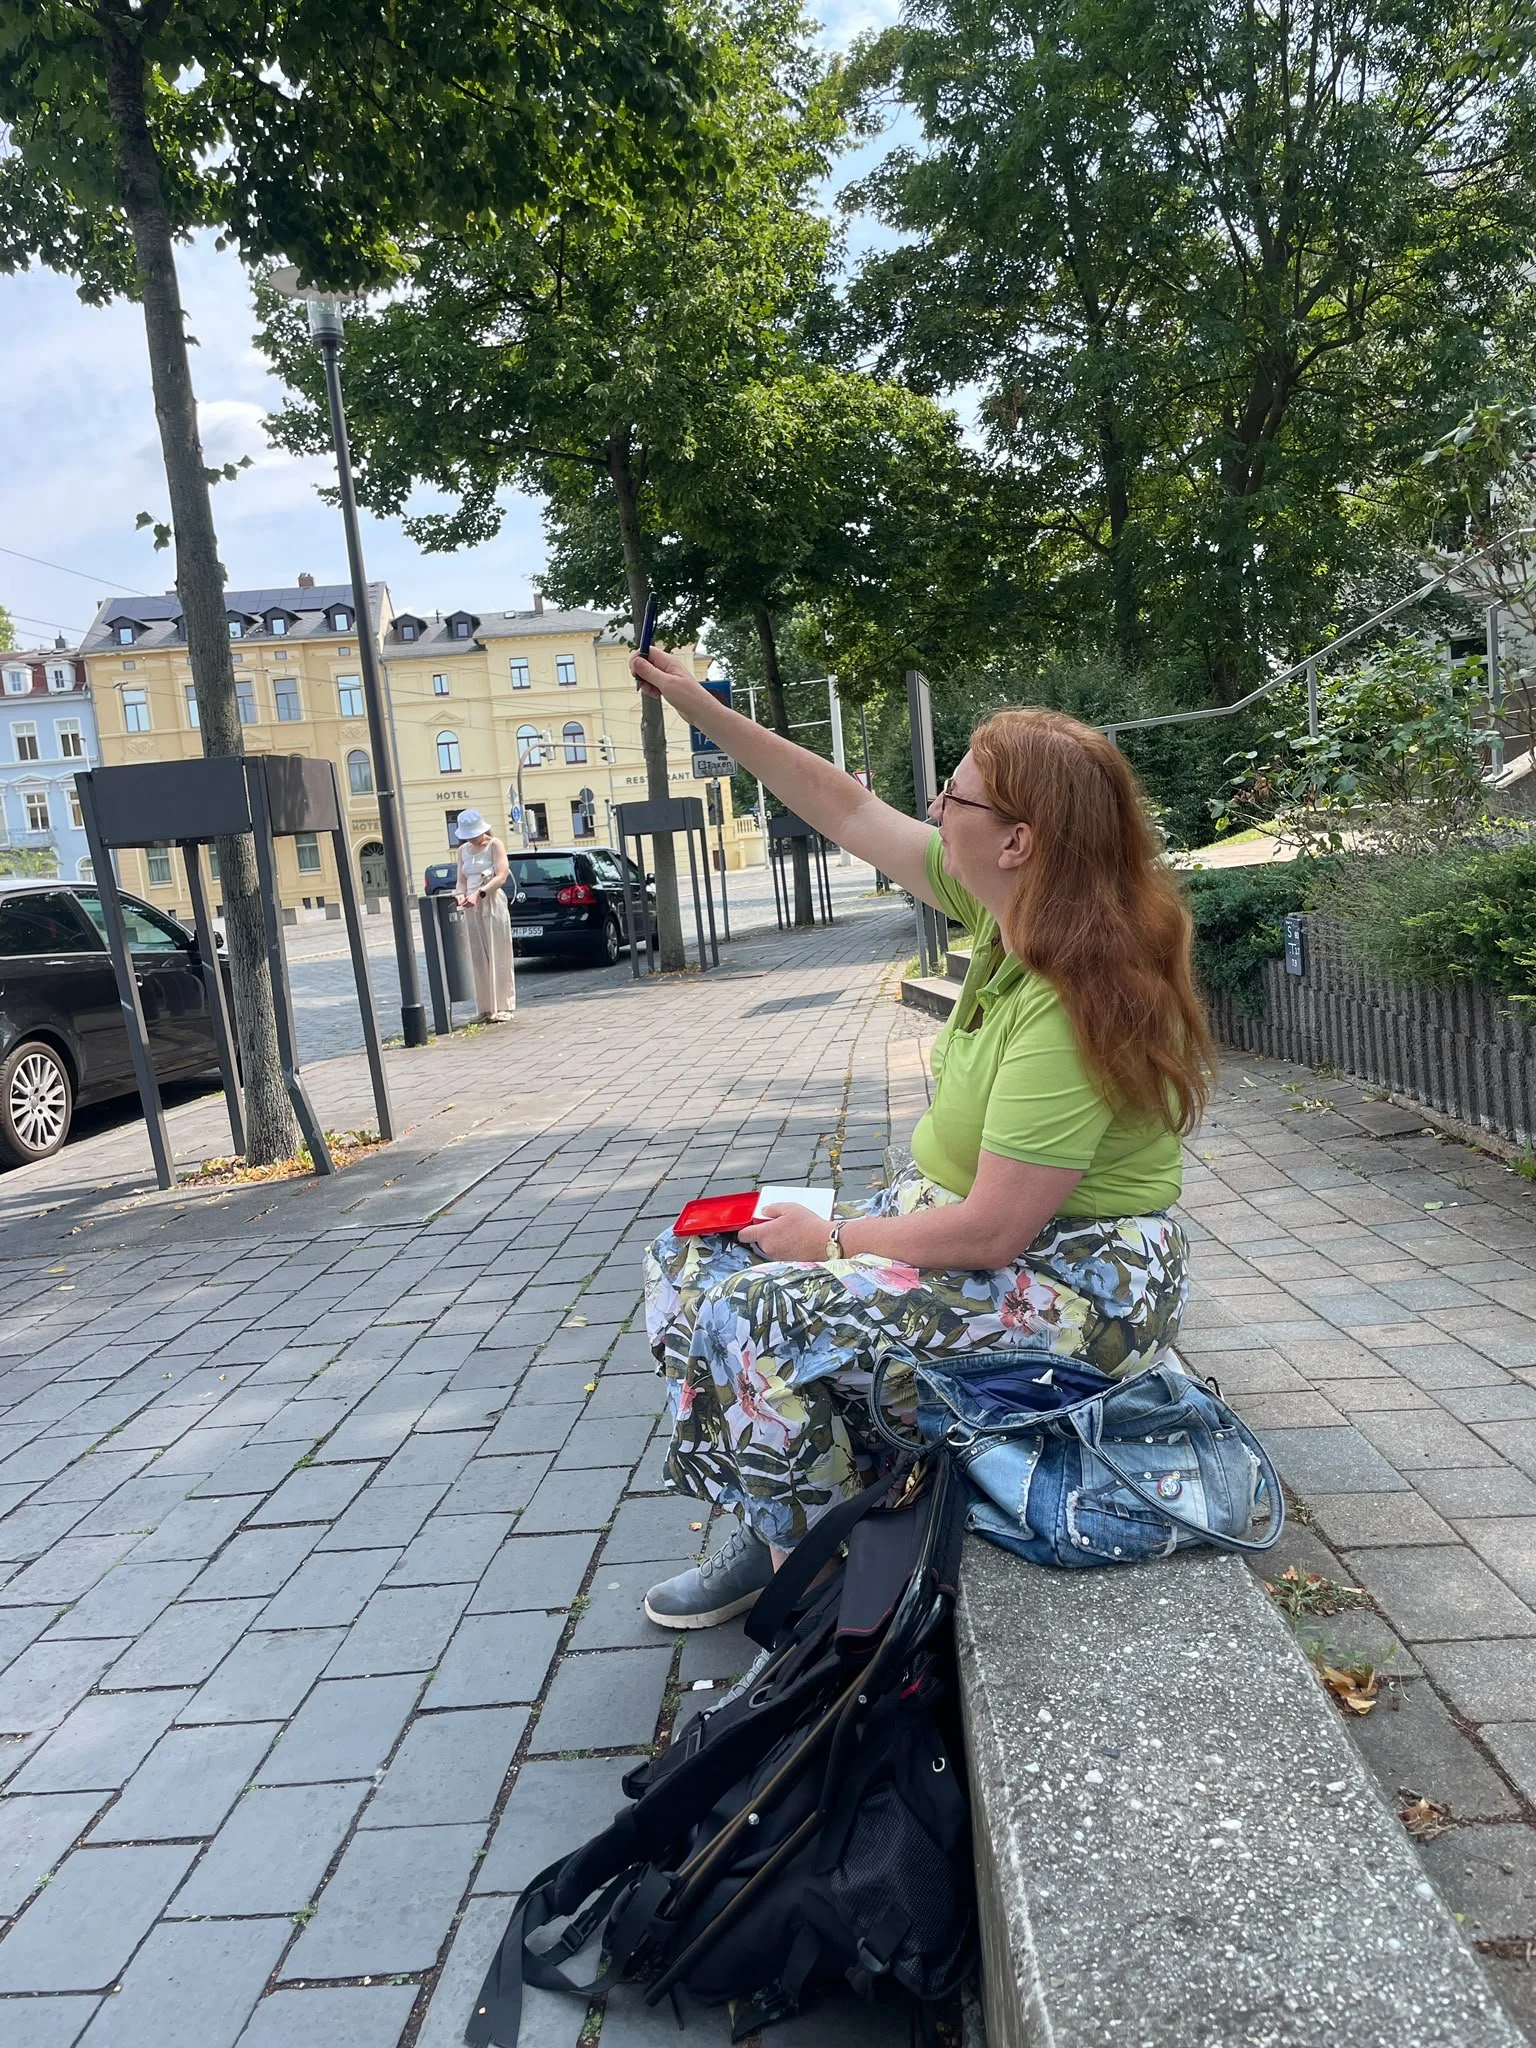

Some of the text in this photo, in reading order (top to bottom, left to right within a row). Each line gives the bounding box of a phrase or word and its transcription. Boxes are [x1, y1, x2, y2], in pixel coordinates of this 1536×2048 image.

[706, 761, 732, 769] Taxen
[626, 771, 690, 785] RESRANT
[436, 790, 470, 801] HOTEL
[352, 822, 380, 832] HOTE
